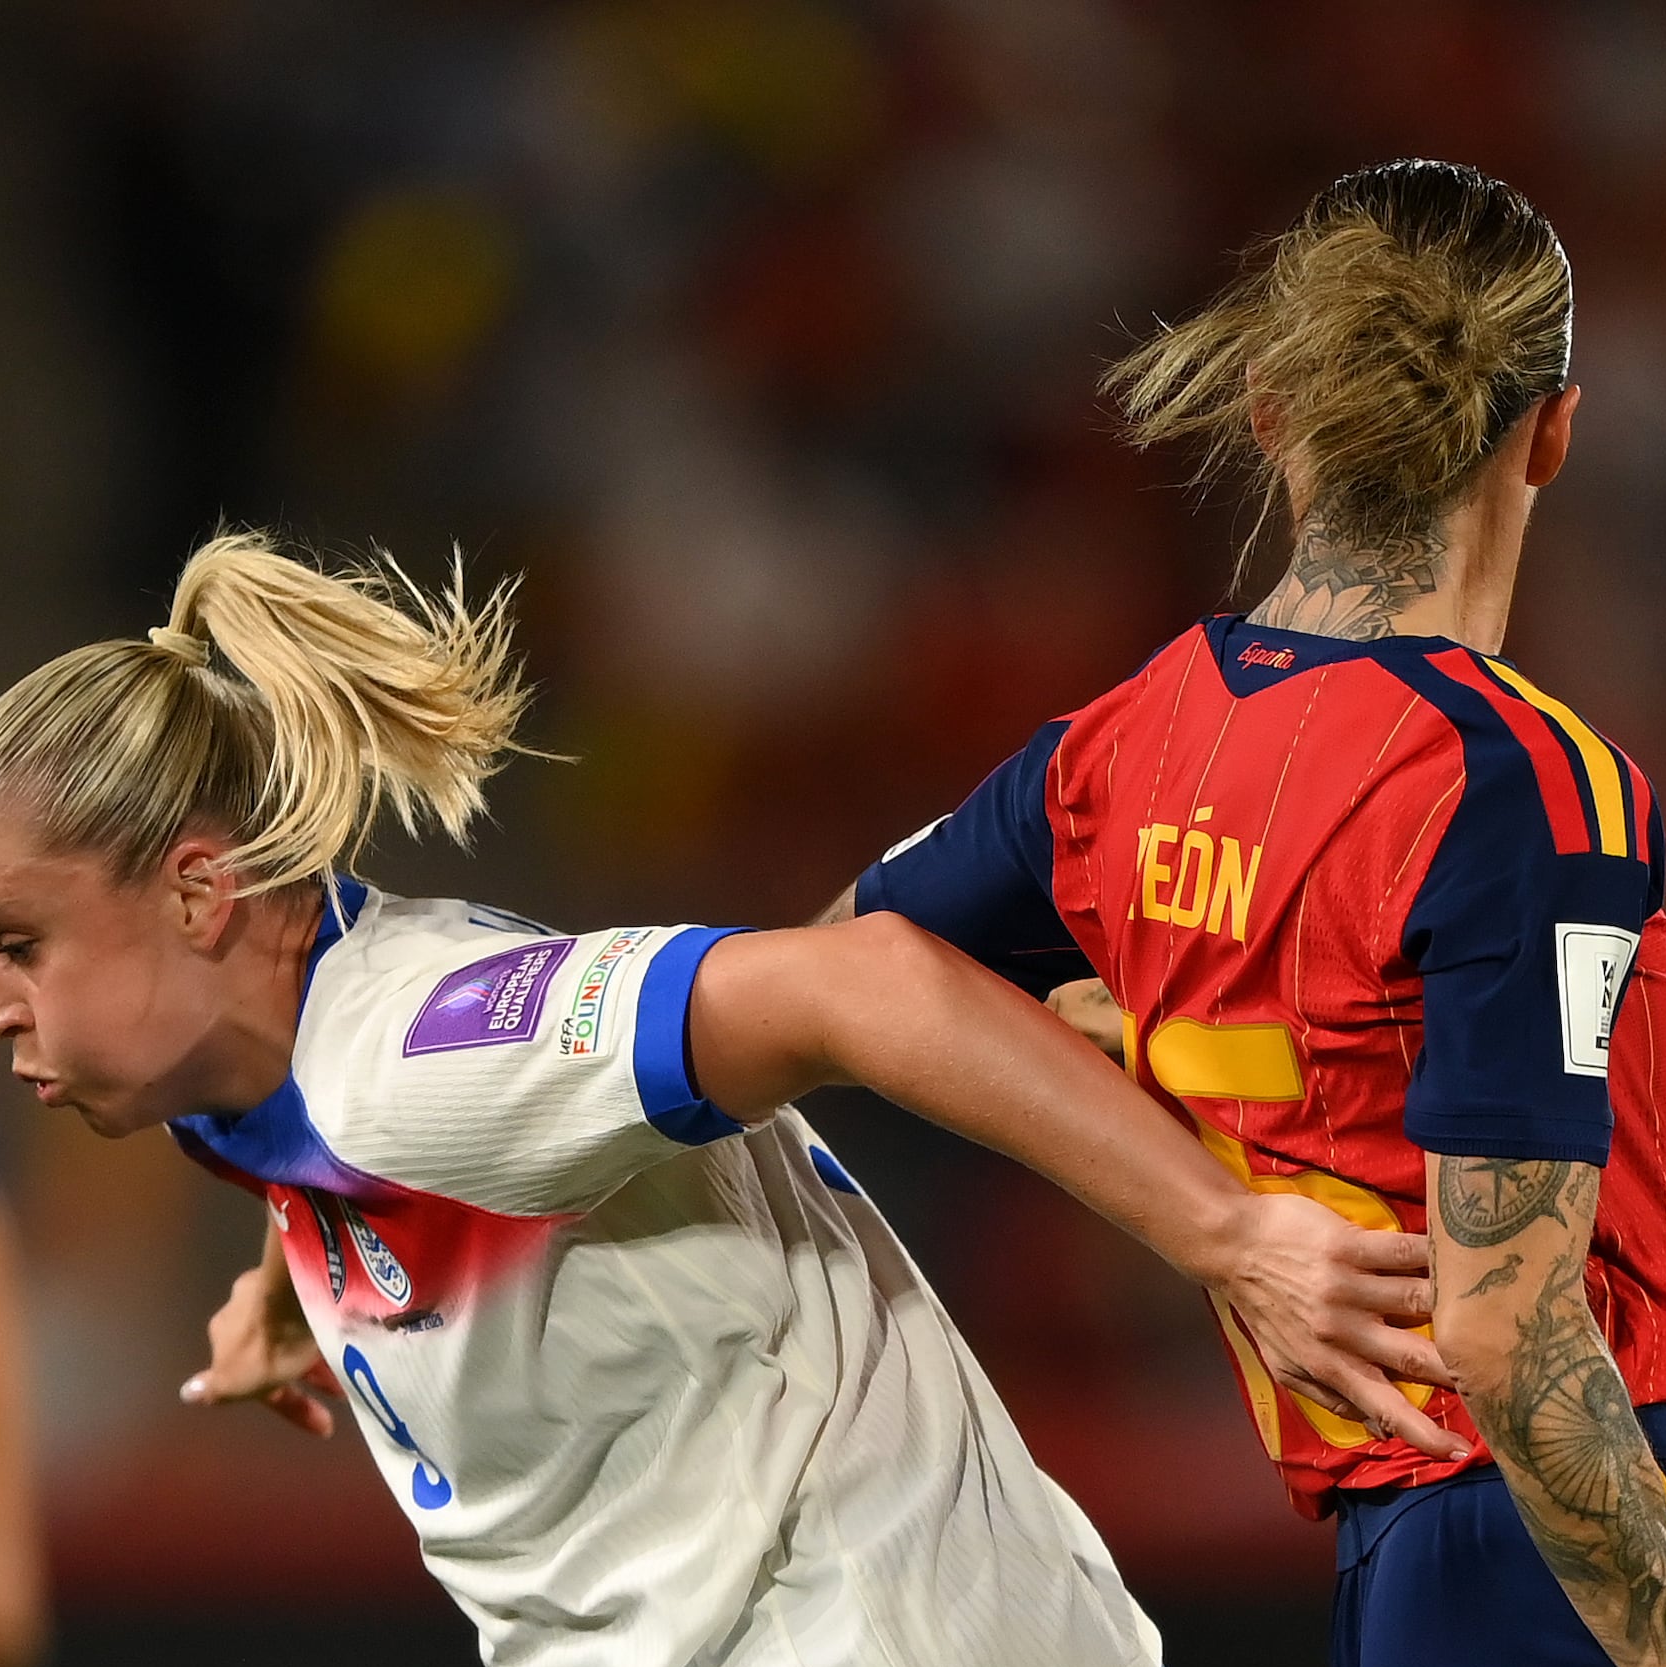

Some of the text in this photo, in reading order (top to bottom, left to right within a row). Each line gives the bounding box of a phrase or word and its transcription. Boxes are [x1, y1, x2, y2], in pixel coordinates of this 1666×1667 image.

[1237, 641, 1296, 671] España
[488, 952, 538, 1030] EUROPEAN
[503, 948, 553, 1031] QUALIFIERS
[572, 930, 641, 1055] FOUNDATION
[559, 1017, 576, 1056] UEFA
